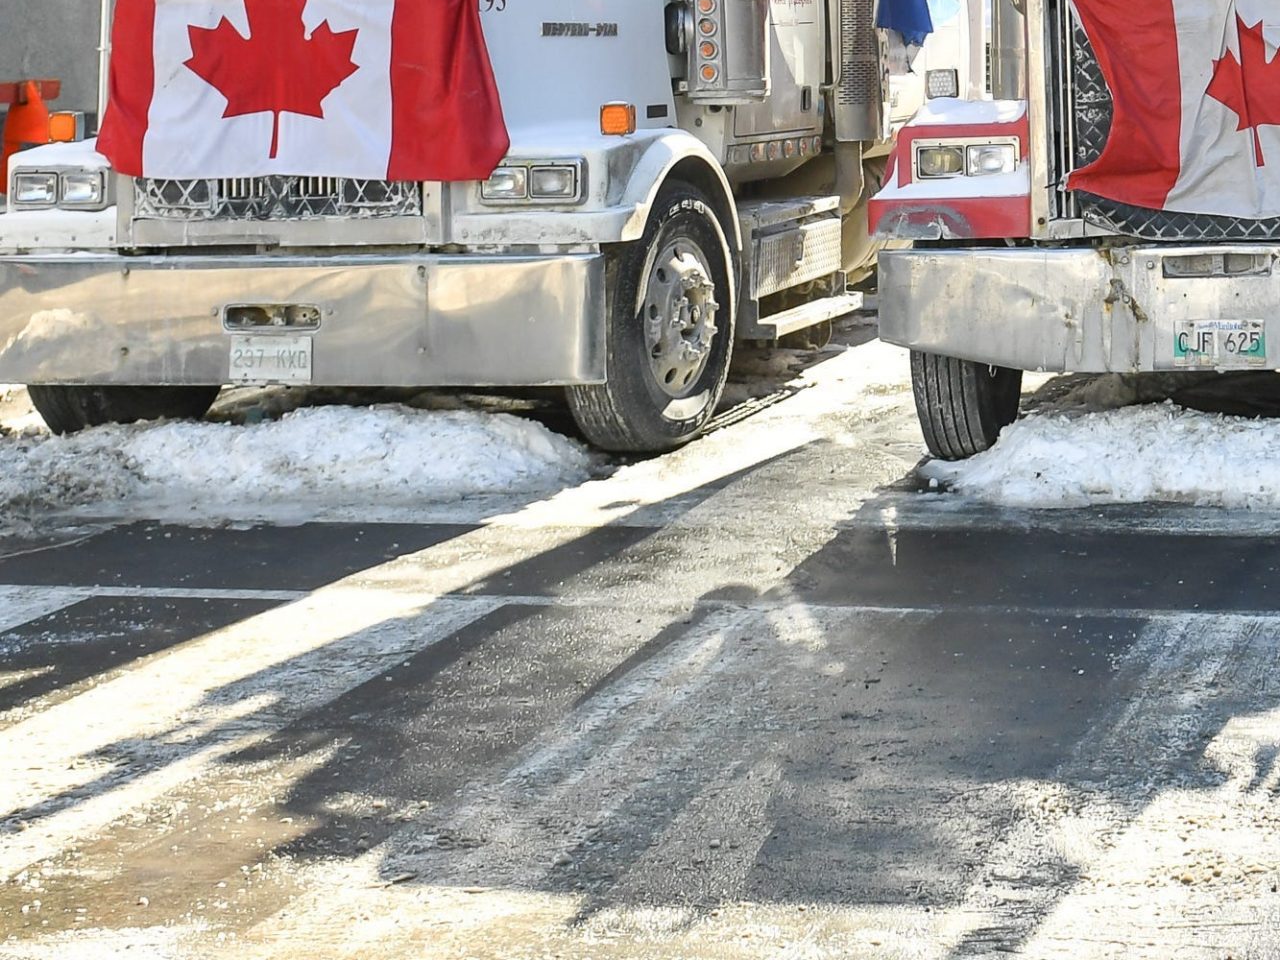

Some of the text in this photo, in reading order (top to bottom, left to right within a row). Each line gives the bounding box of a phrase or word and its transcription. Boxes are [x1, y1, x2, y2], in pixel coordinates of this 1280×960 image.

[1178, 332, 1260, 352] CJF 625
[233, 348, 264, 368] 237
